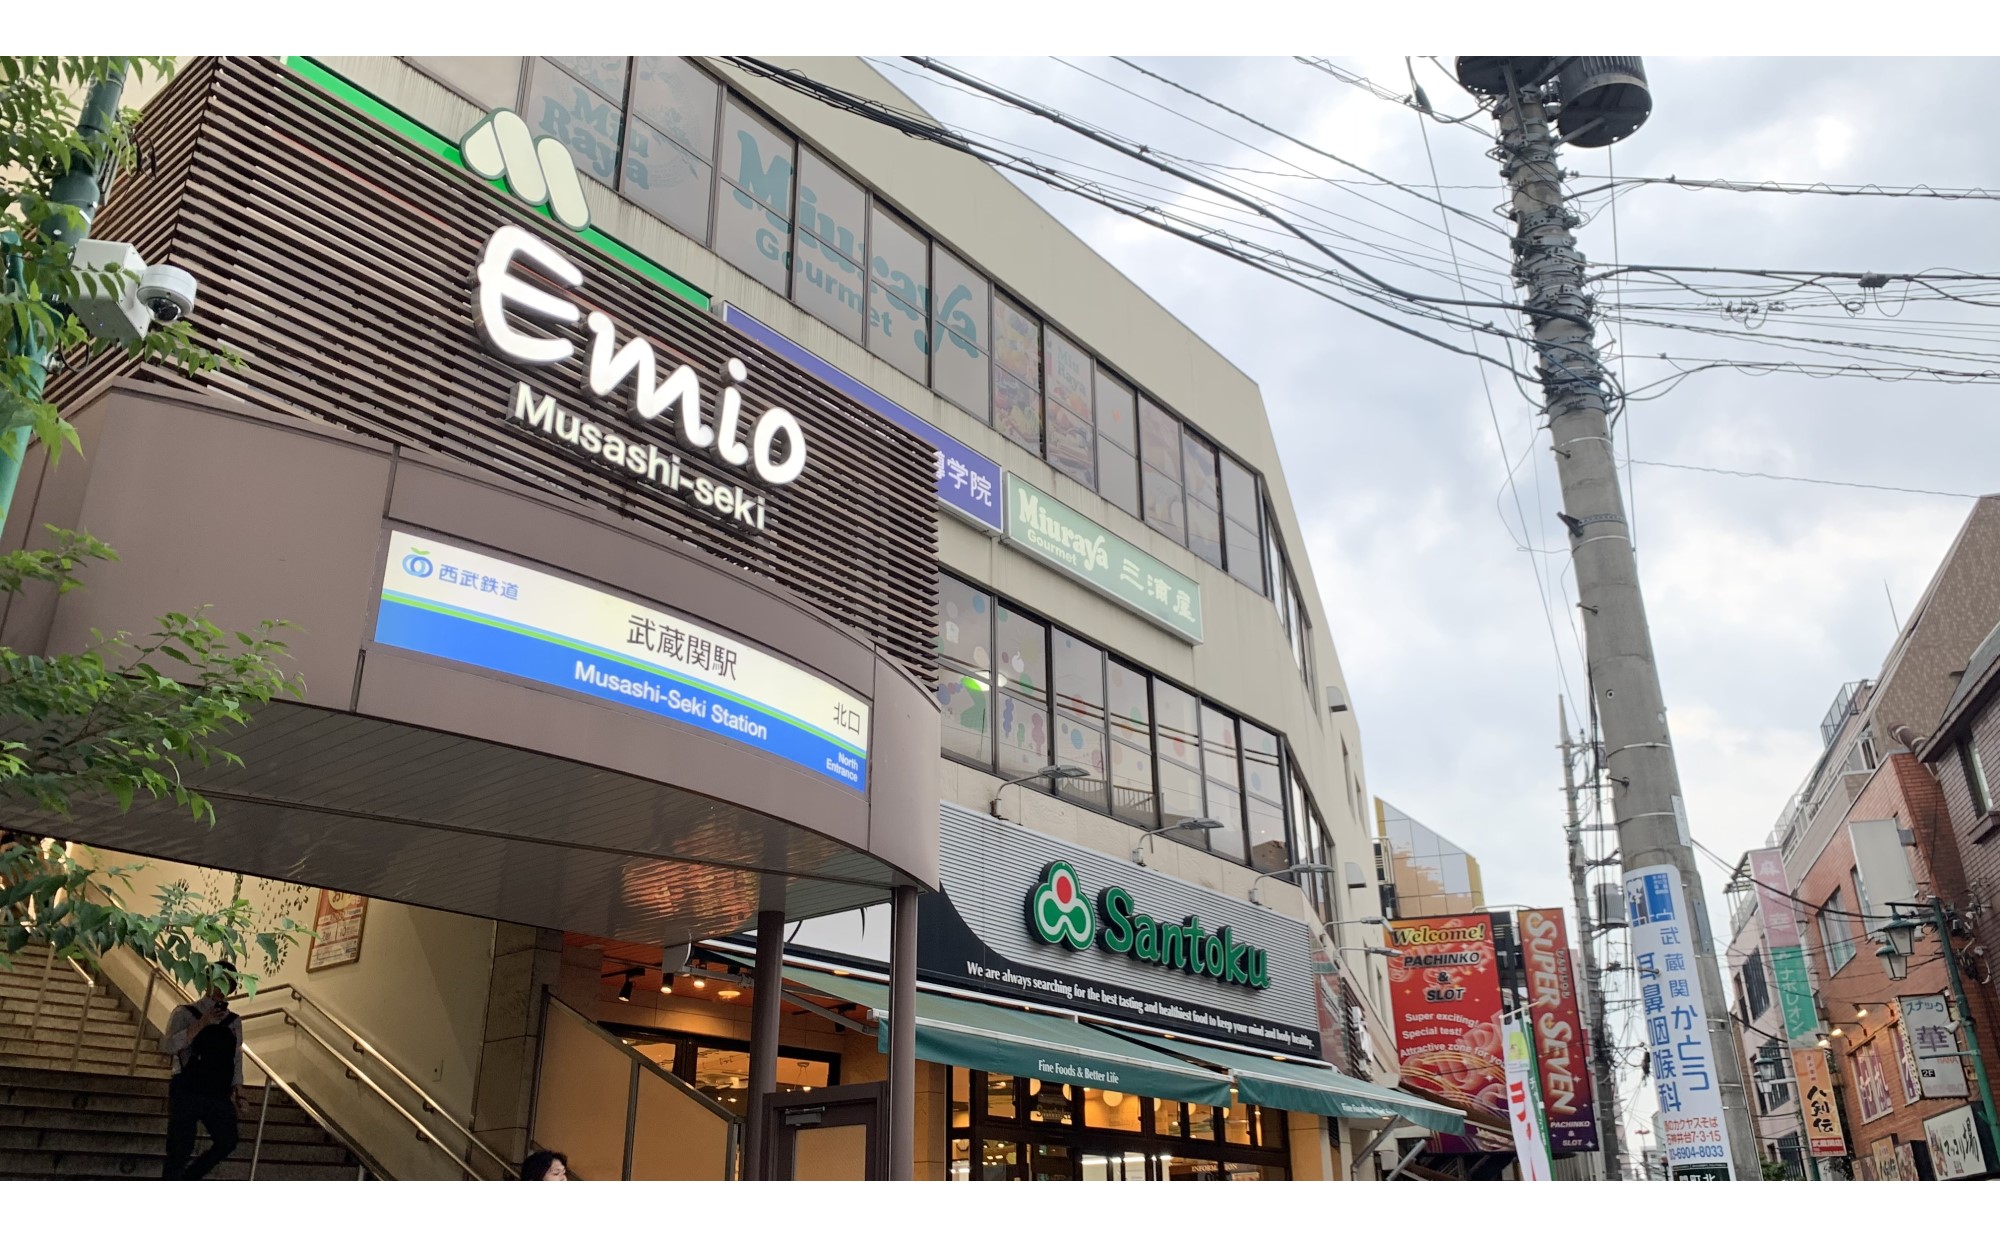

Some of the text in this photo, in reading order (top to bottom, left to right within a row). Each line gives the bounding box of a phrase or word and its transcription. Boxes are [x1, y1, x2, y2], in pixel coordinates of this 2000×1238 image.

[539, 96, 649, 190] Raya
[755, 228, 892, 337] Gourmet
[477, 224, 807, 485] Emio
[512, 381, 766, 533] Musashi-seki
[1018, 487, 1109, 571] Miuraya
[1027, 530, 1077, 567] Gourmet
[438, 563, 520, 601] 西武鉄道
[626, 614, 738, 681] 武蔵関駅
[574, 660, 767, 741] Musashi-Seki Station
[833, 702, 861, 736] 北口
[826, 758, 858, 783] Entrance
[838, 752, 859, 771] North
[1102, 886, 1271, 990] Santoku
[1392, 923, 1485, 946] Welcome!
[1404, 951, 1480, 968] PACHINKO
[1437, 971, 1449, 983] &
[1526, 912, 1561, 1007] SUPER
[966, 960, 983, 977] We
[985, 968, 1001, 981] are
[1002, 969, 1032, 990] always
[1033, 979, 1073, 999] searching
[1074, 984, 1086, 998] for
[1087, 988, 1100, 1001] the
[1101, 989, 1118, 1005] best
[1119, 995, 1144, 1015] tasting
[1144, 1002, 1158, 1014] and
[1158, 1003, 1192, 1021] healthiest
[1193, 1010, 1208, 1025] food
[1209, 1015, 1217, 1026] to
[1217, 1015, 1233, 1033] keep
[1426, 988, 1465, 1002] SLOT
[1659, 926, 1710, 1092] 武蔵関かとう
[1905, 1001, 1944, 1016] スナック
[1402, 1026, 1438, 1040] Special
[1405, 1013, 1479, 1029] Super exciting!
[1636, 952, 1682, 1114] 耳鼻咽喉科
[1400, 1042, 1446, 1058] Attractive
[1448, 1043, 1472, 1053] zone
[1474, 1047, 1489, 1059] for
[1538, 1012, 1577, 1115] SEVEN
[1038, 1059, 1119, 1084] Fine Foods & Better Life
[1550, 1120, 1591, 1129] PACHINKO
[1807, 1085, 1834, 1133] 八剣伝
[1562, 1139, 1582, 1147] SLOT
[1191, 1163, 1238, 1173] INFORMION
